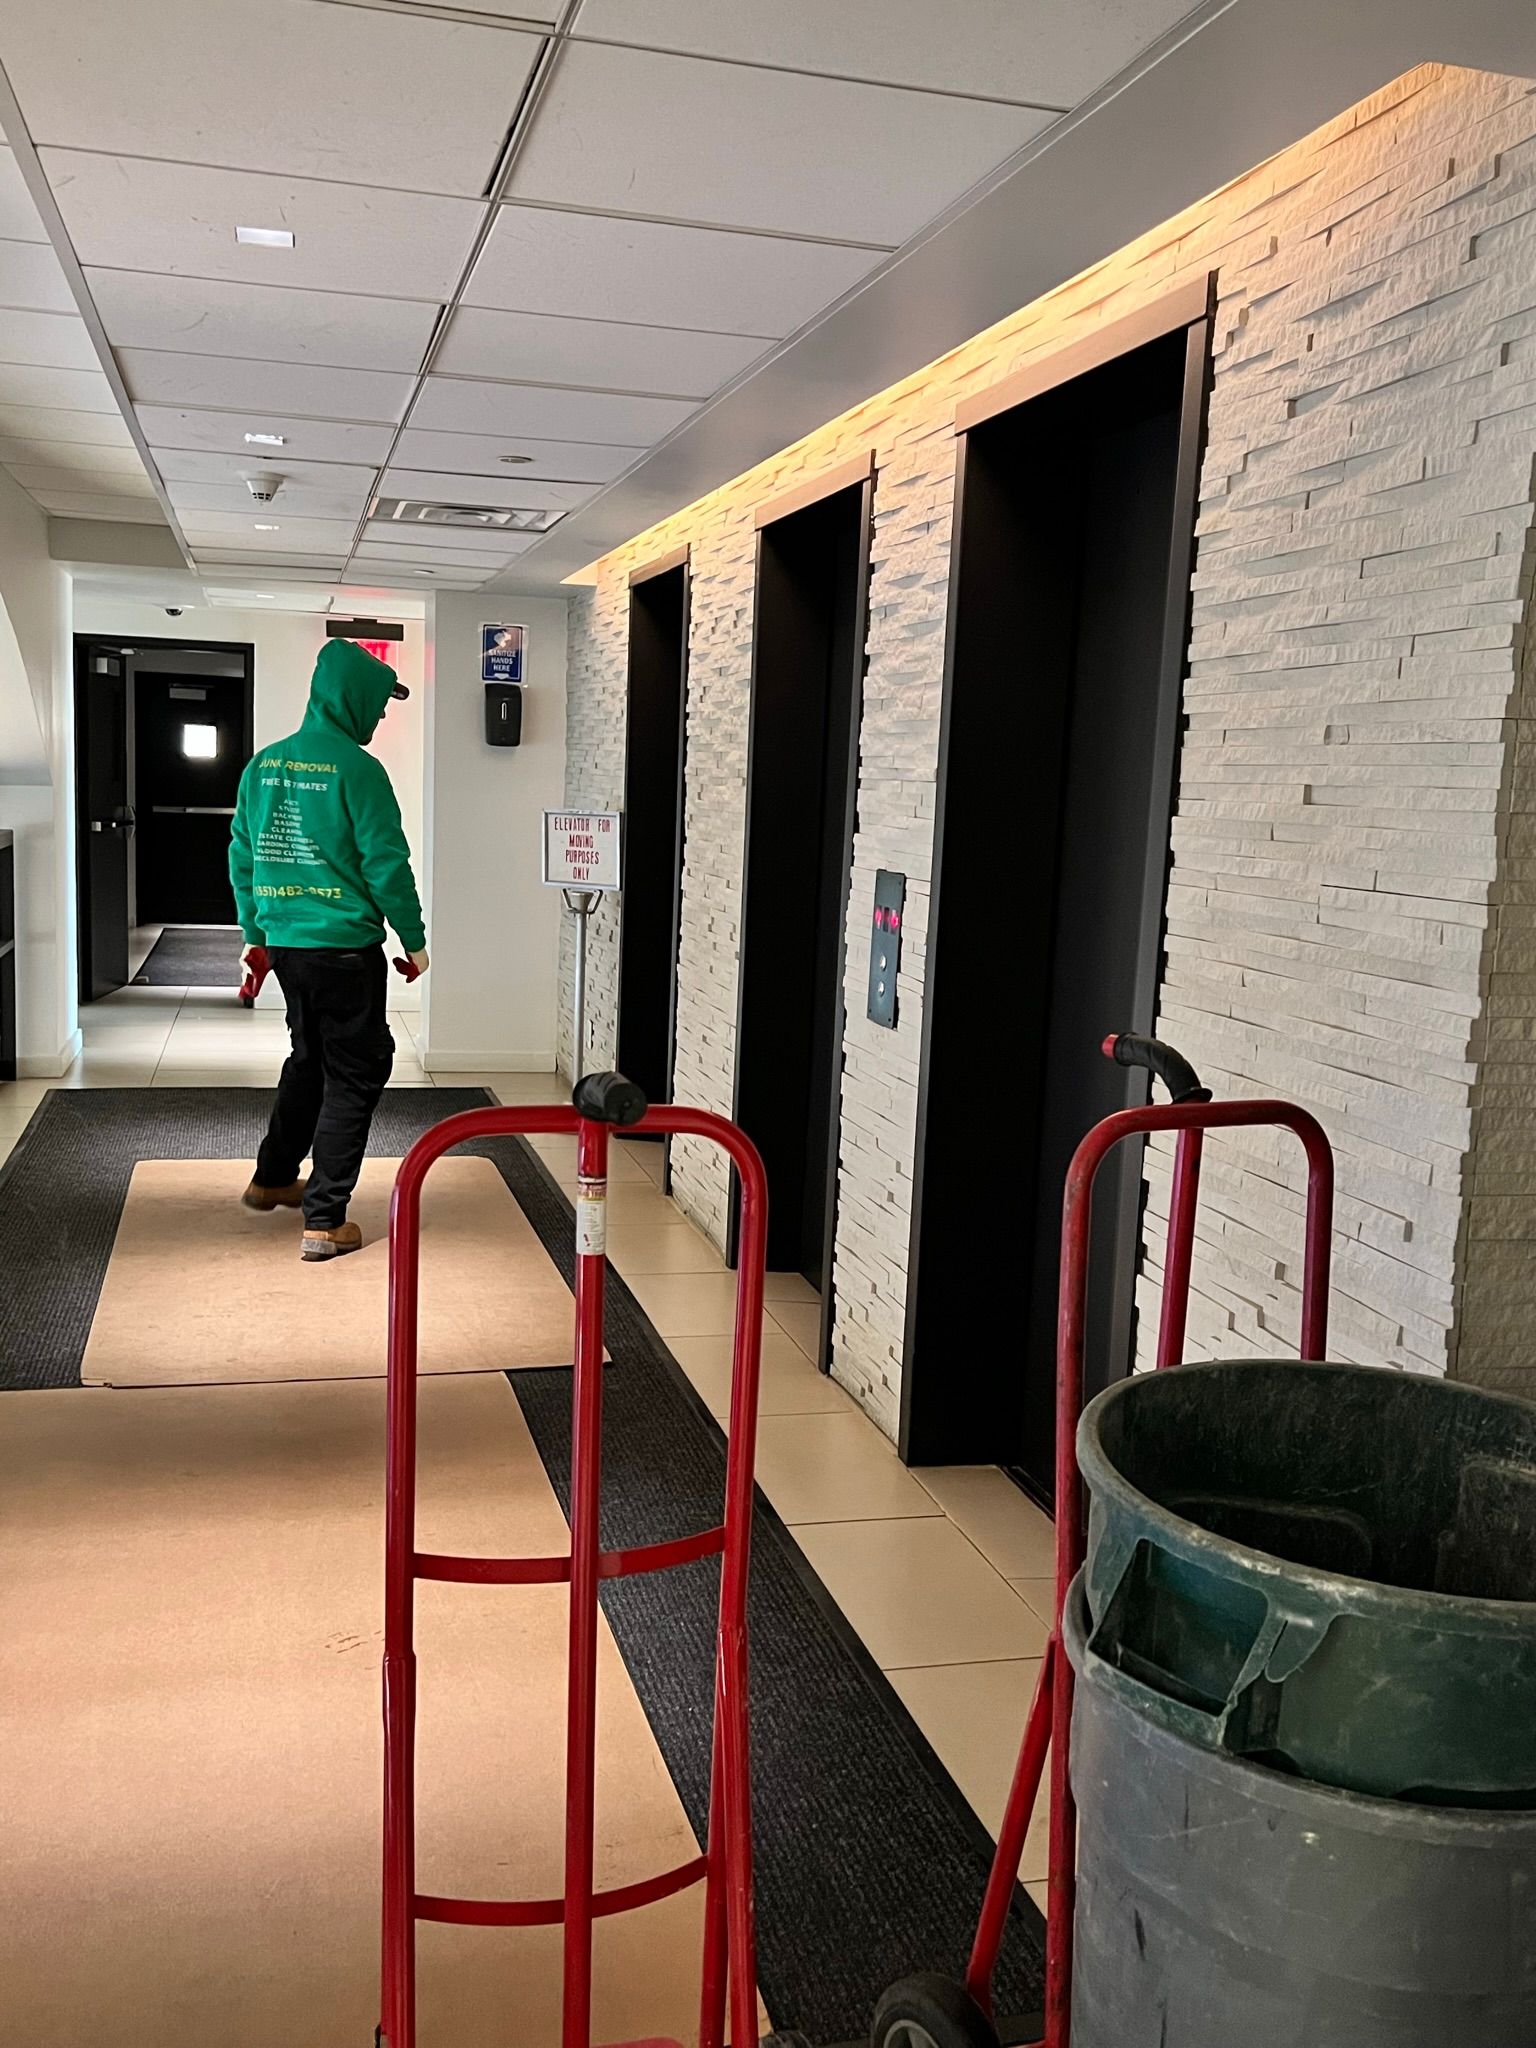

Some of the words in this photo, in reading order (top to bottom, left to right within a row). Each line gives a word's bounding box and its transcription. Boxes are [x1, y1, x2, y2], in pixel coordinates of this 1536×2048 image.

[491, 657, 513, 665] HANDS
[493, 664, 510, 672] HERE
[259, 758, 282, 769] JUNK
[284, 760, 338, 773] REMOVAL
[554, 816, 590, 832] ELEVATOR
[598, 818, 611, 833] FOR
[568, 834, 594, 848] MOVING
[565, 849, 600, 865] PURPOSES
[572, 866, 590, 881] ONLY
